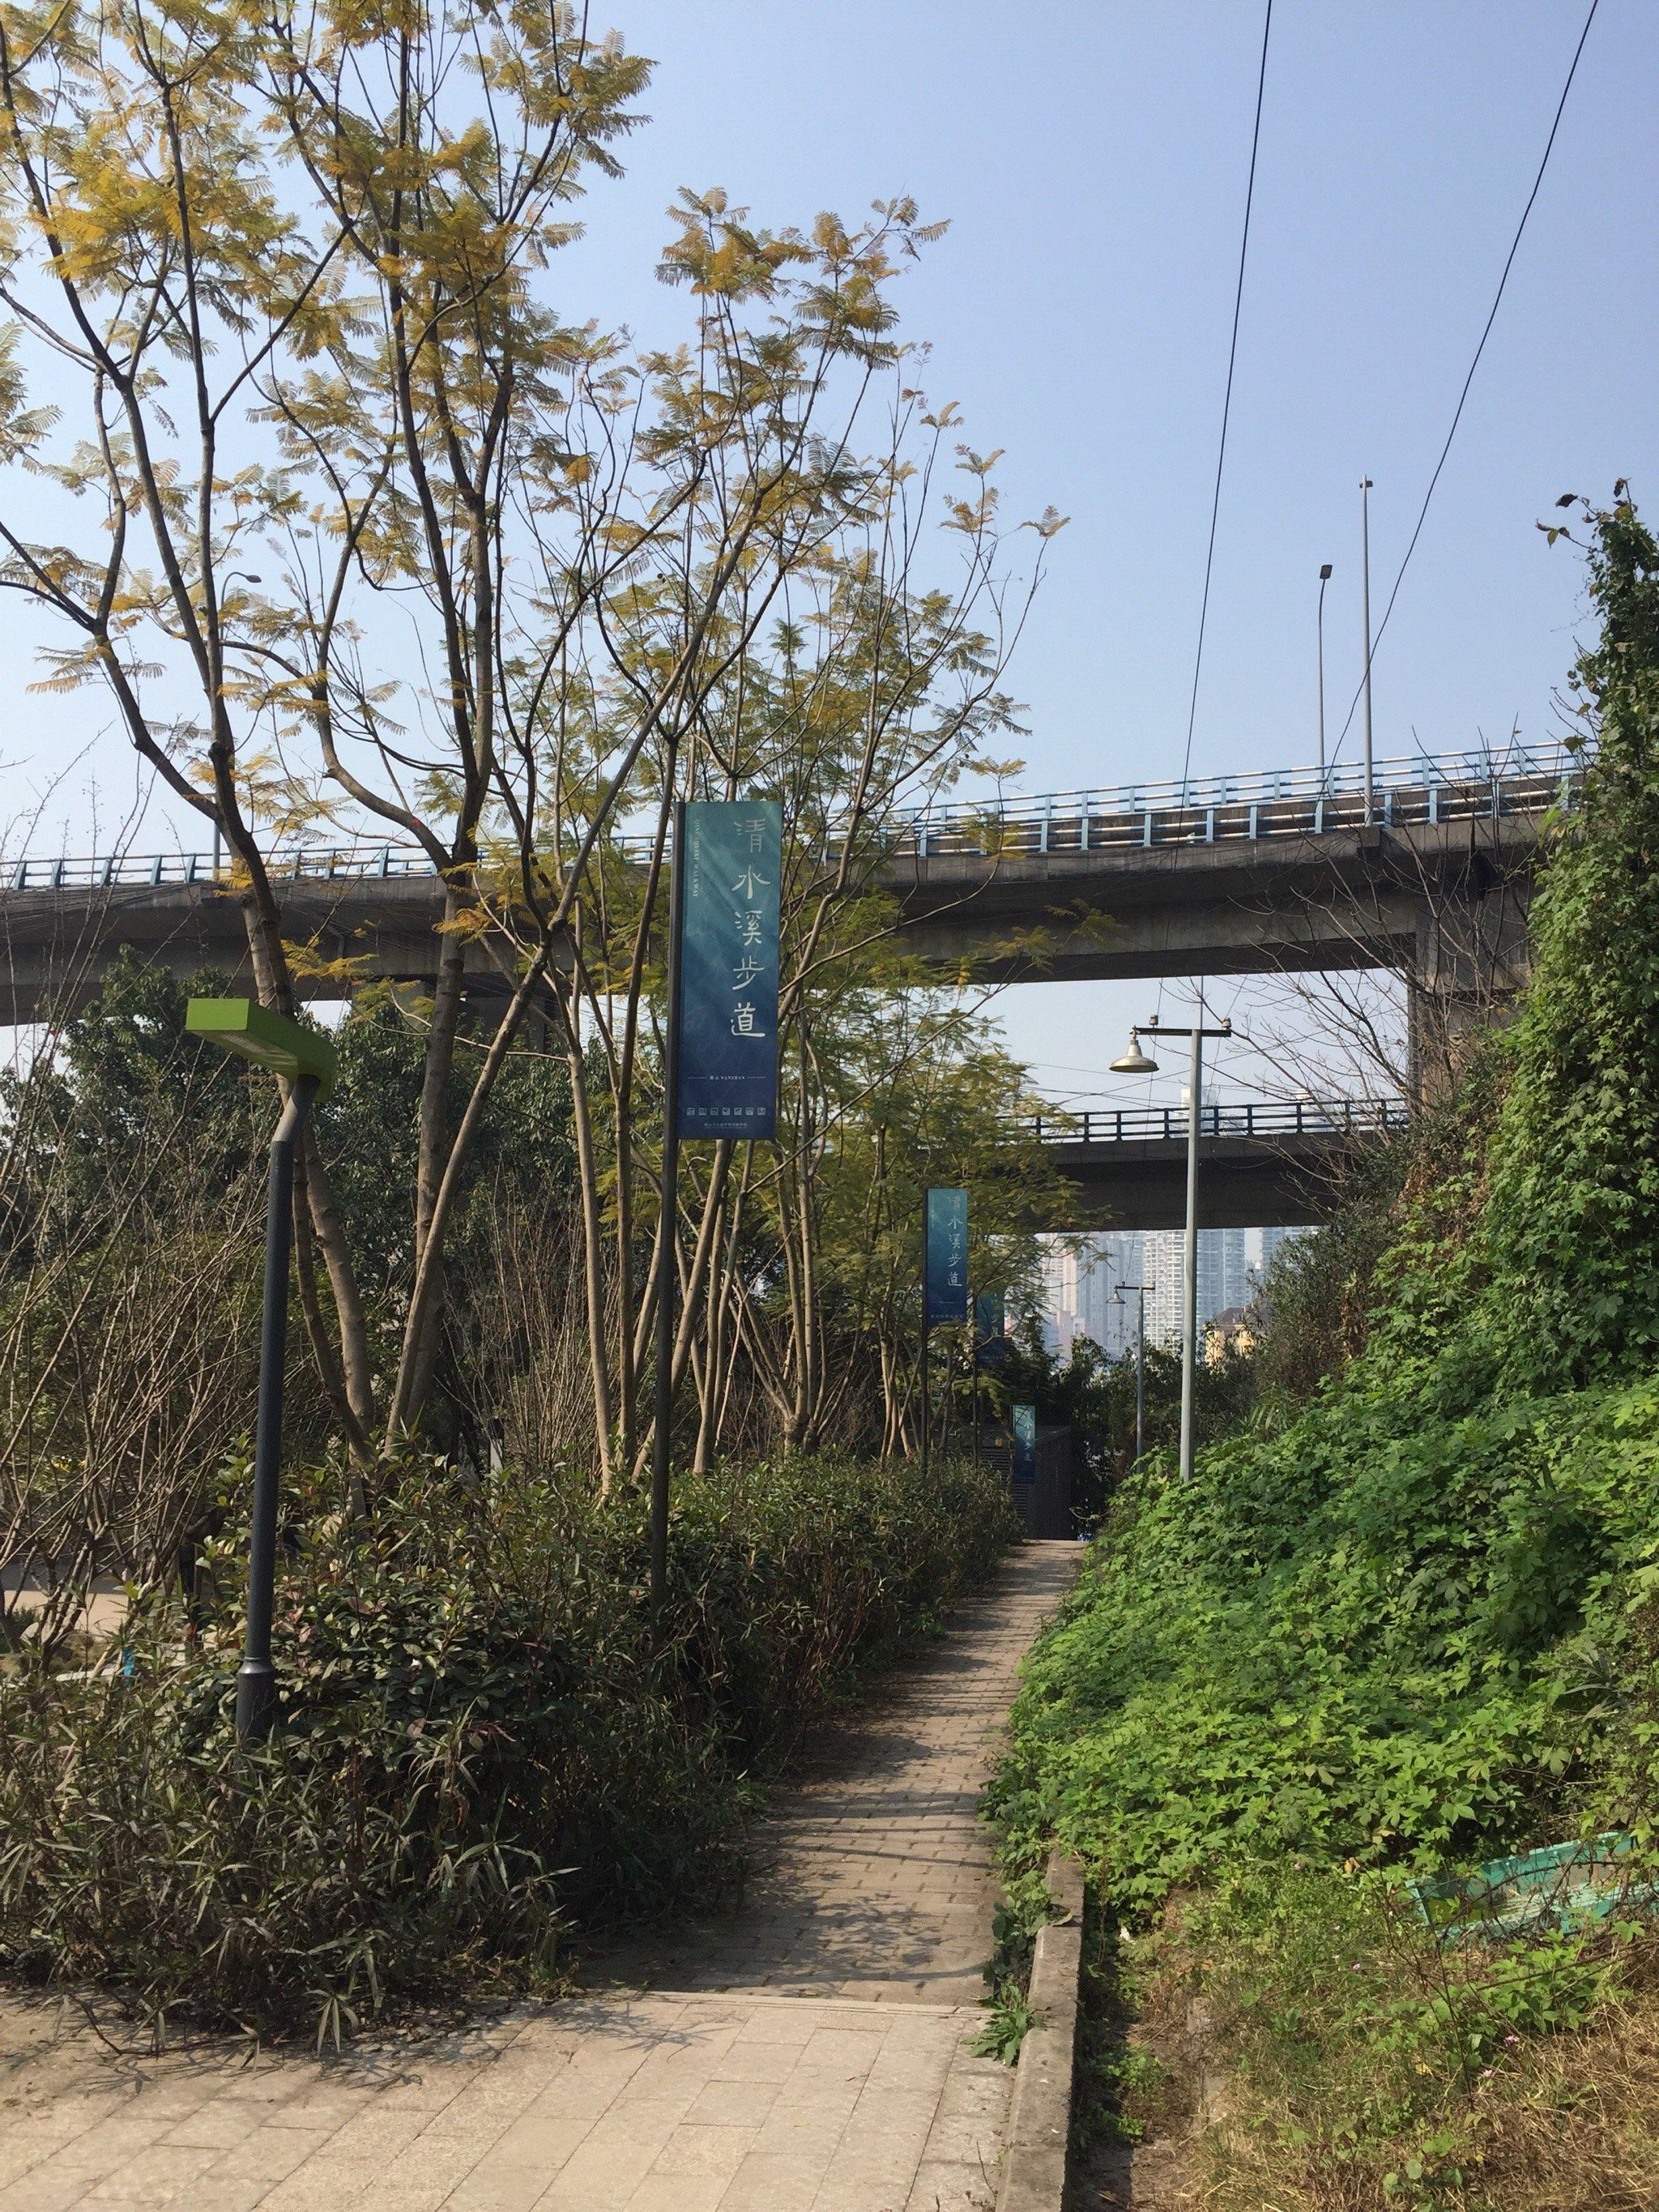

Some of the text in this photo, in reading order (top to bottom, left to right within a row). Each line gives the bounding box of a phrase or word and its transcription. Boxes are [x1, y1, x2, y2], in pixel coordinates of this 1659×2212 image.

[731, 818, 770, 1038] 清水溪步道
[947, 1196, 963, 1287] 清水溪步道
